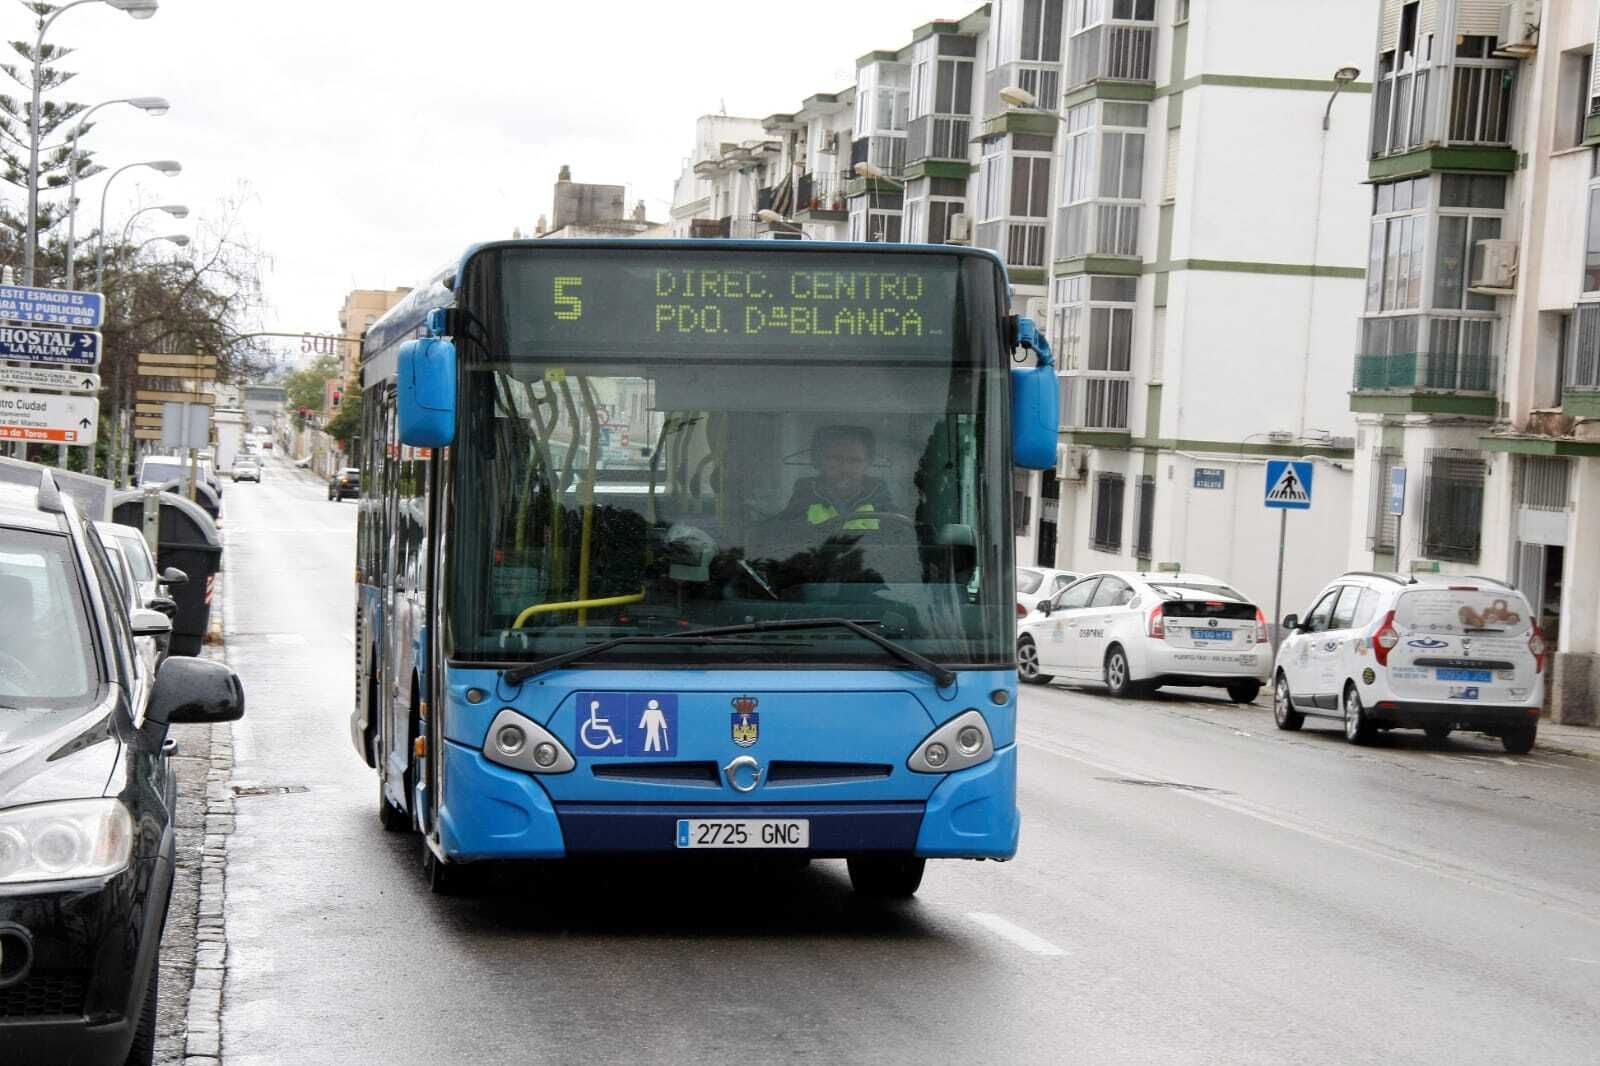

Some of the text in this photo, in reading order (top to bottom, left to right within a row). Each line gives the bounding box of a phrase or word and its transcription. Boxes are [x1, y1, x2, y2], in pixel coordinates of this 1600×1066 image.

[656, 269, 922, 300] DIREC. CENTRO
[0, 288, 84, 305] ESTE ESPACIO ES
[554, 276, 582, 320] 5
[0, 299, 95, 317] RA TU PUBLICIDAD
[656, 304, 728, 333] PDO.
[0, 328, 76, 348] HOSTAL
[16, 399, 47, 411] Ciudad
[10, 429, 21, 438] de
[23, 429, 48, 439] Toros
[697, 823, 800, 845] 2725 GNC
